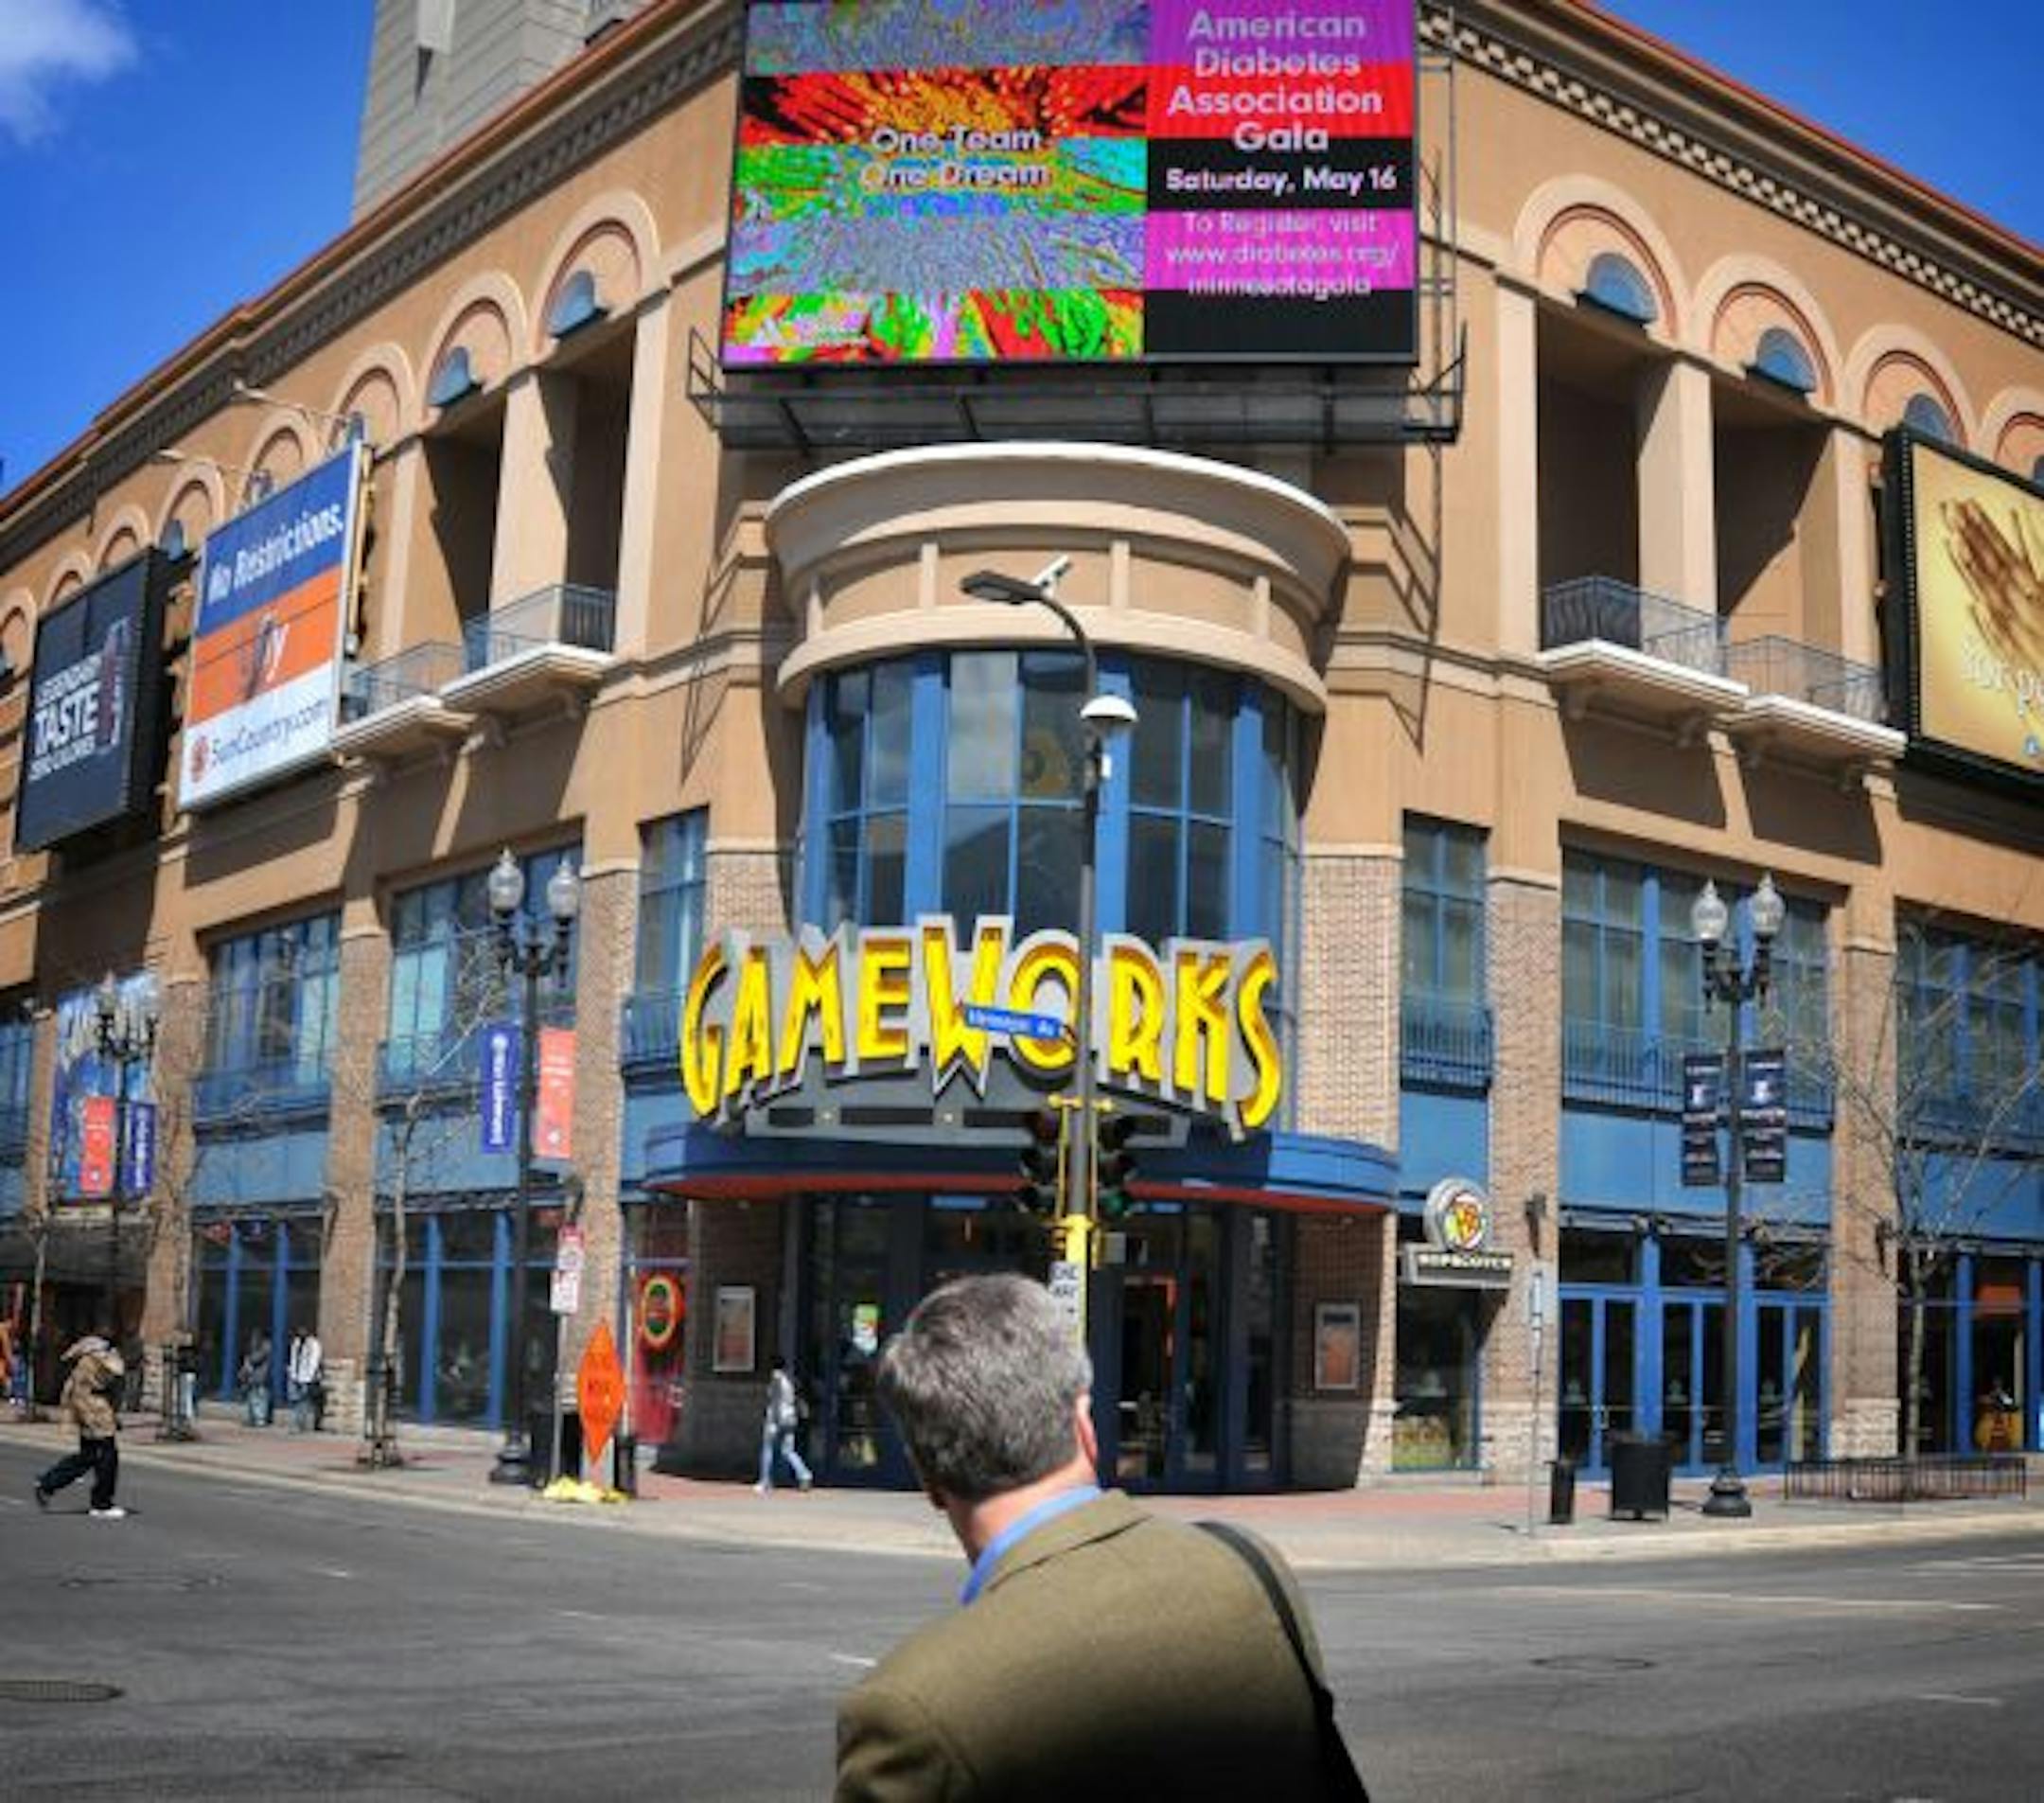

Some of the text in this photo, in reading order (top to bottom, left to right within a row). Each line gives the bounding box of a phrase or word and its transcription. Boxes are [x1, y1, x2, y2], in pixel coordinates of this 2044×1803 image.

[1187, 9, 1366, 41] American
[1194, 47, 1361, 78] Diabetes
[1168, 84, 1383, 115] Association
[872, 125, 1042, 152] One Team
[1234, 121, 1329, 151] Gala
[860, 163, 1050, 188] One Dream
[1166, 166, 1398, 197] Saturday, May 16
[1183, 212, 1213, 233] To
[1330, 211, 1378, 233] visit
[34, 681, 100, 756] TASTE
[679, 916, 1282, 1130] GAMEWORKS
